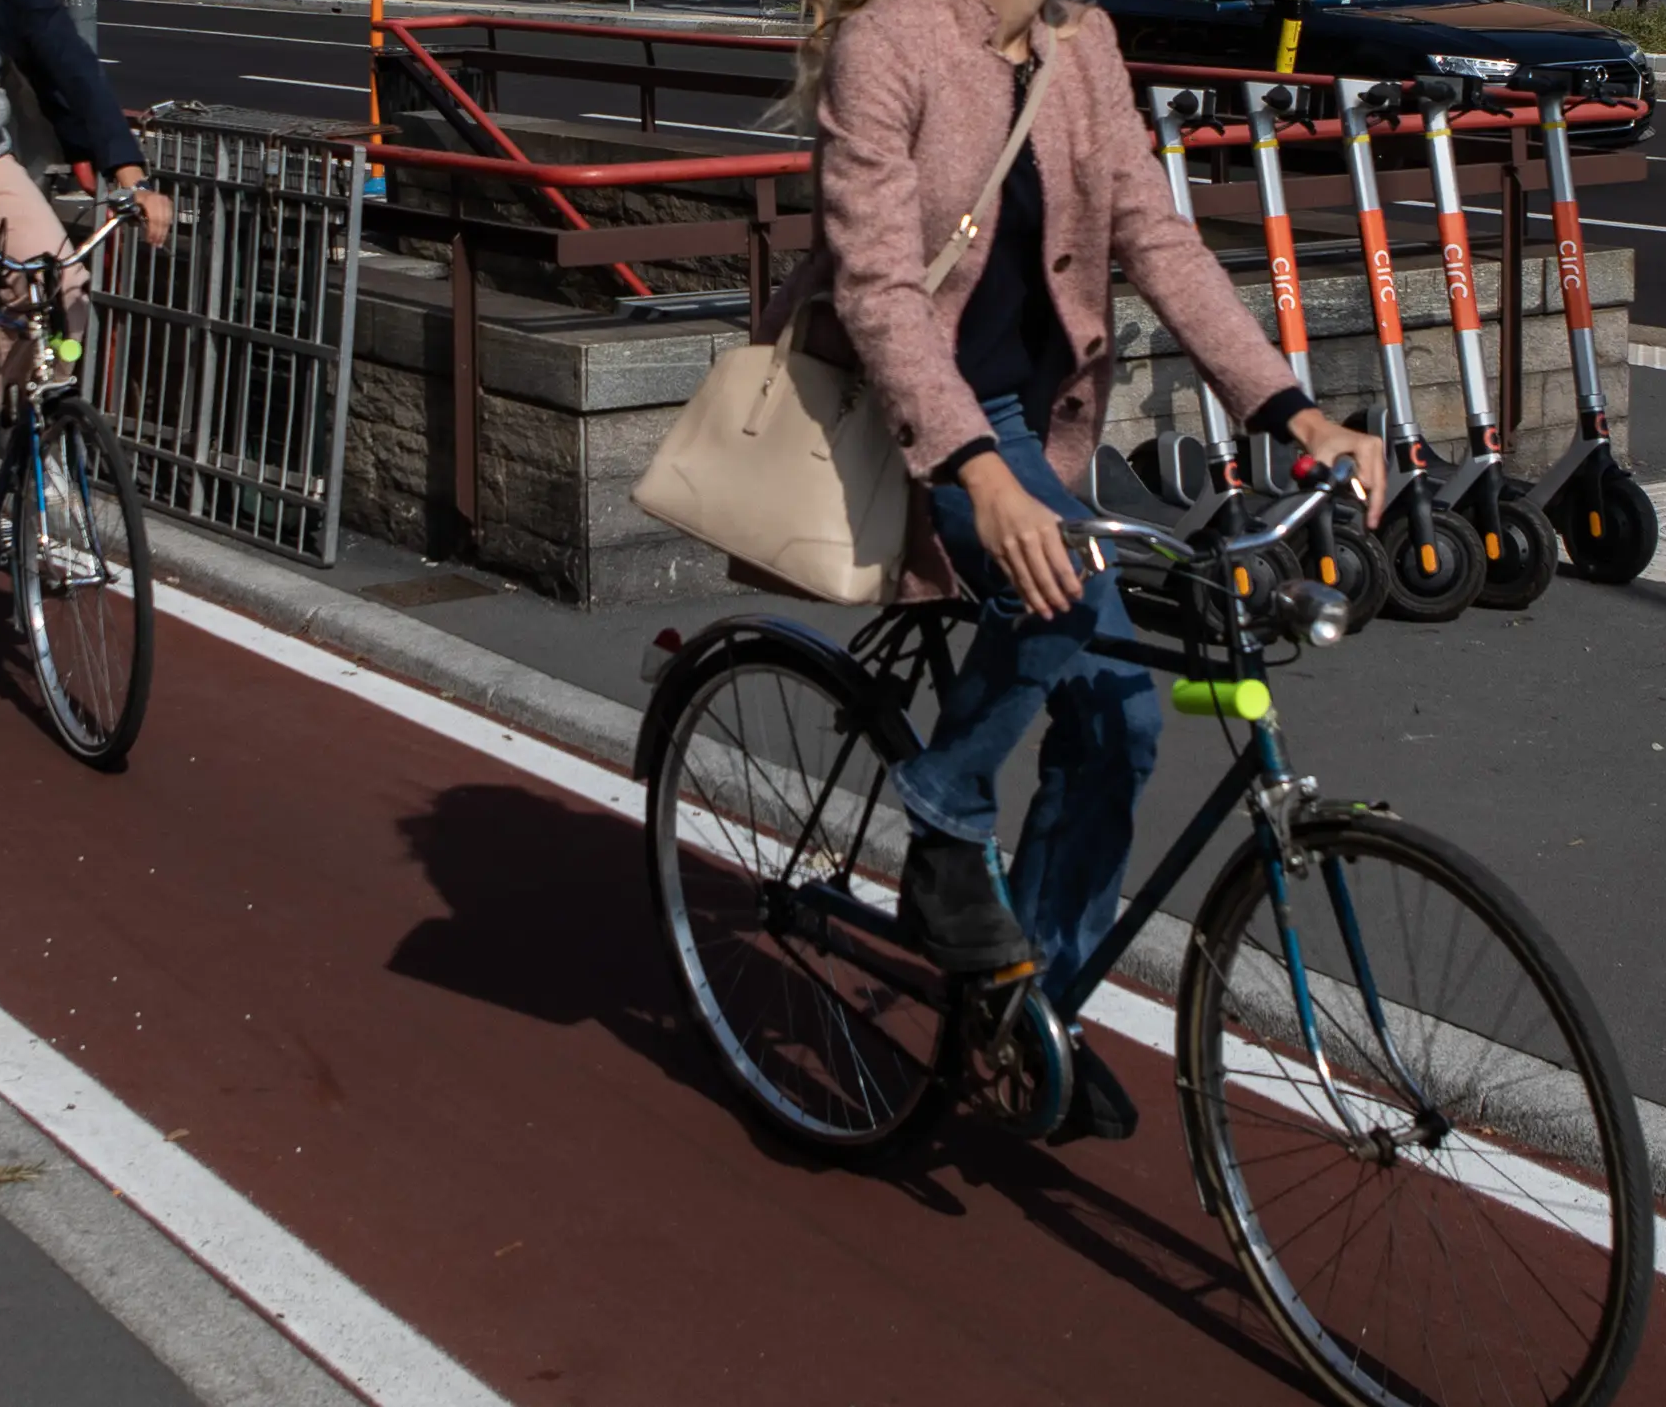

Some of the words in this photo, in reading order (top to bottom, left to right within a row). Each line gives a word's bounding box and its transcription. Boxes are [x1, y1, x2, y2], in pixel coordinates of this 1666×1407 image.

[1271, 256, 1296, 311] circ
[1373, 249, 1396, 303] circ
[1443, 243, 1469, 300] circ
[1559, 240, 1581, 291] circ
